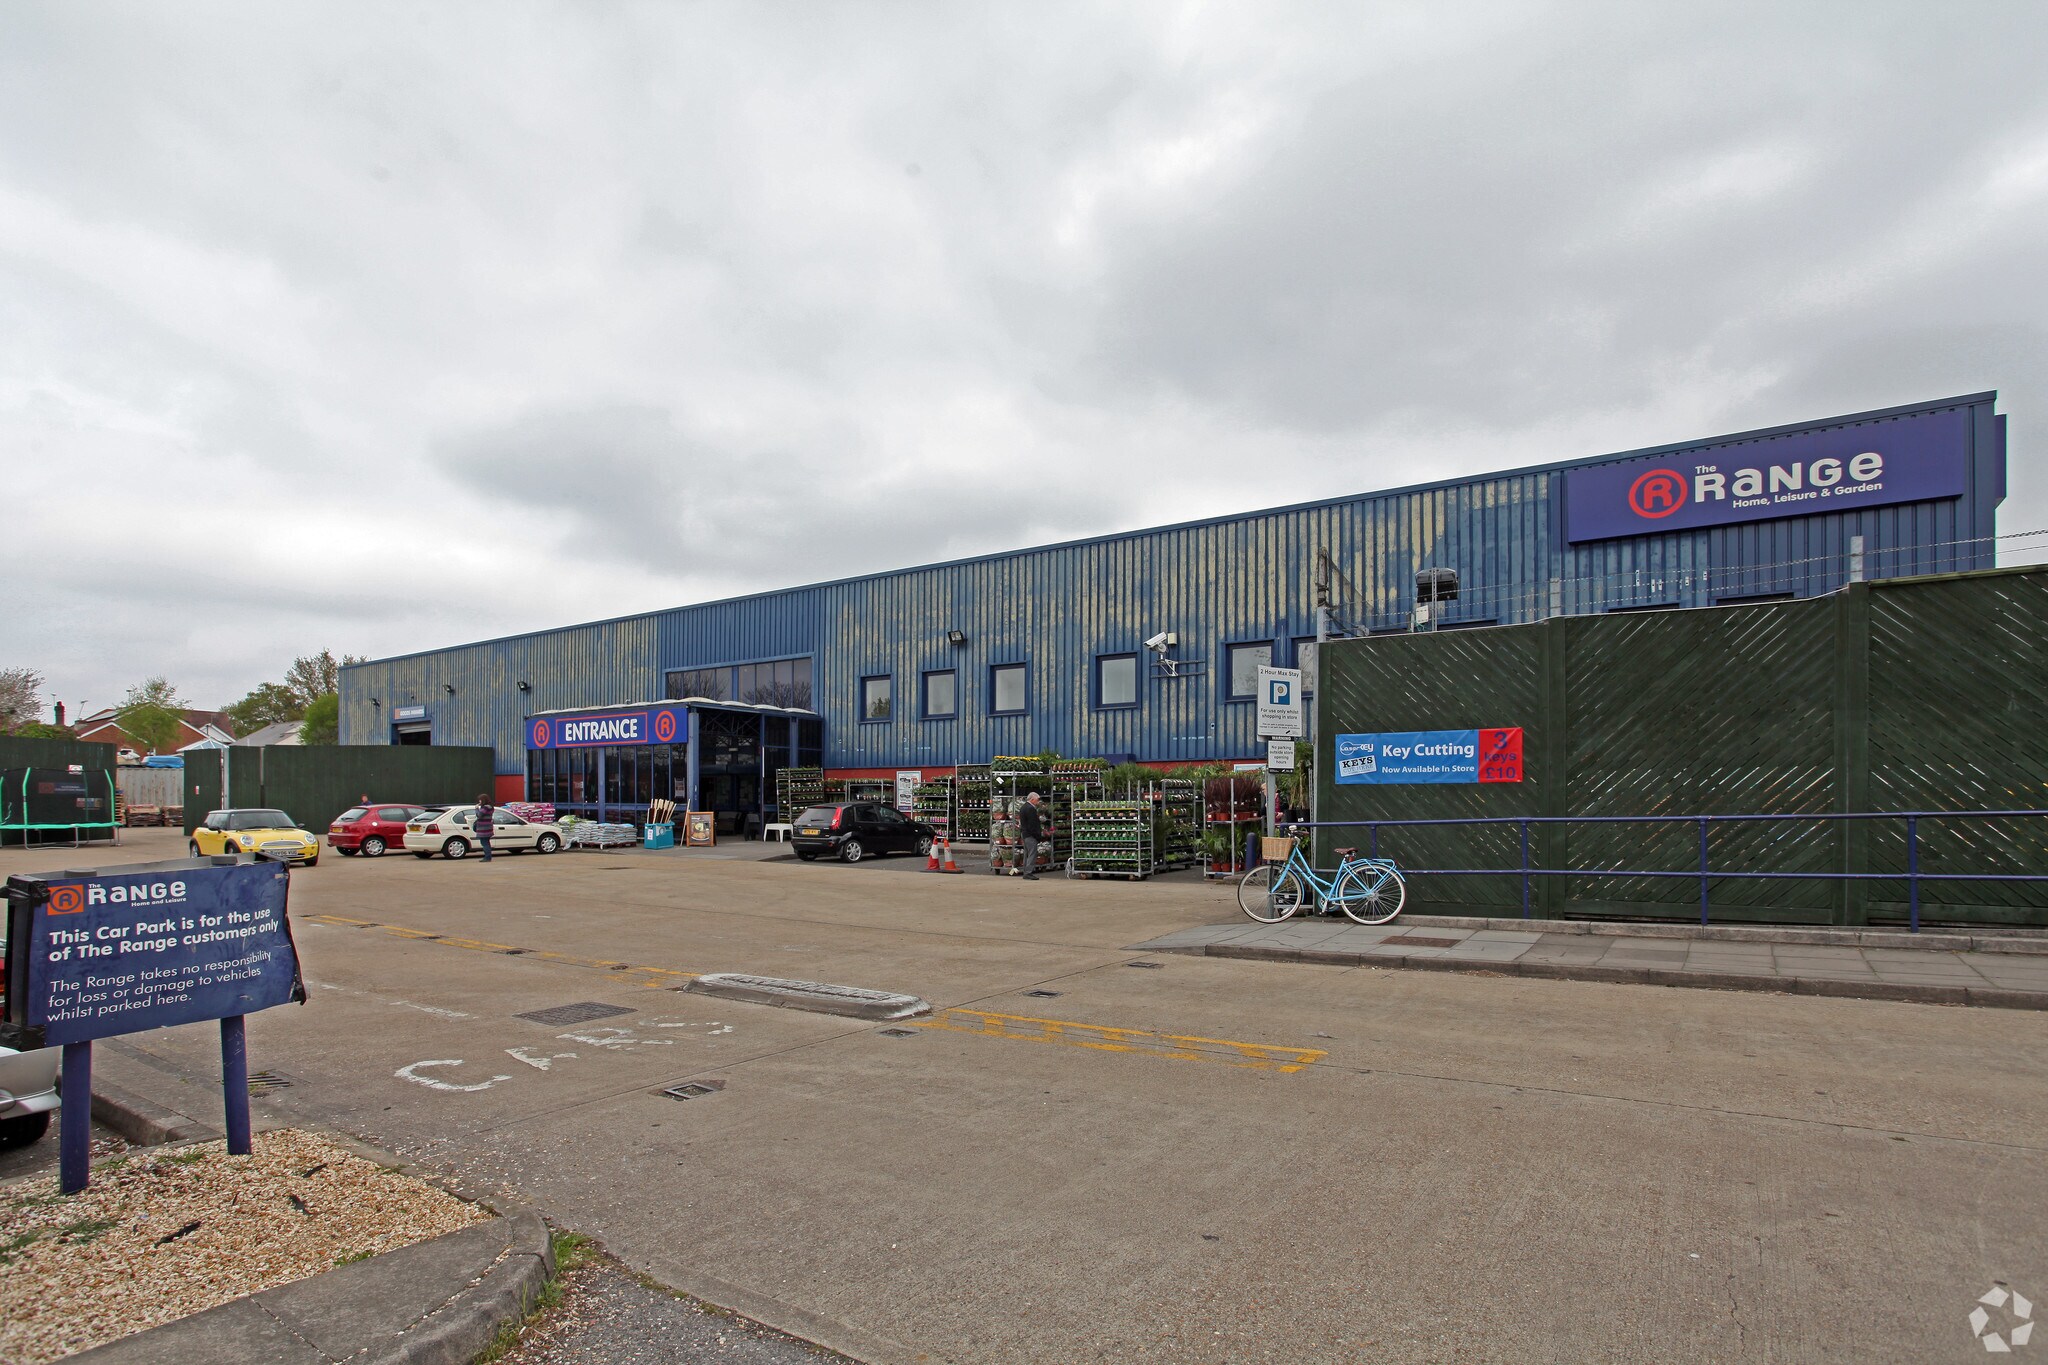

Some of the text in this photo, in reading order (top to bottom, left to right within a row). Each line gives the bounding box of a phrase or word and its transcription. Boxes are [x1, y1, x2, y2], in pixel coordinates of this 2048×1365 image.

[1695, 464, 1717, 474] The
[1732, 482, 1883, 508] Home, Leisure & Garden
[565, 718, 638, 741] ENTRANCE
[1494, 732, 1507, 749] 3
[1382, 743, 1475, 760] Key Cutting
[1484, 752, 1517, 764] keys
[1342, 756, 1373, 768] KEYS
[1381, 766, 1400, 774] Now
[1402, 765, 1440, 773] Available
[1486, 766, 1516, 779] £10
[49, 908, 271, 945] This Car Park is for the use
[49, 918, 279, 962] of The Range customers only
[50, 950, 271, 993] The Range takes no responsibility
[48, 967, 262, 1008] for loss or damage to vehicles
[47, 993, 192, 1021] whilst parked here.
